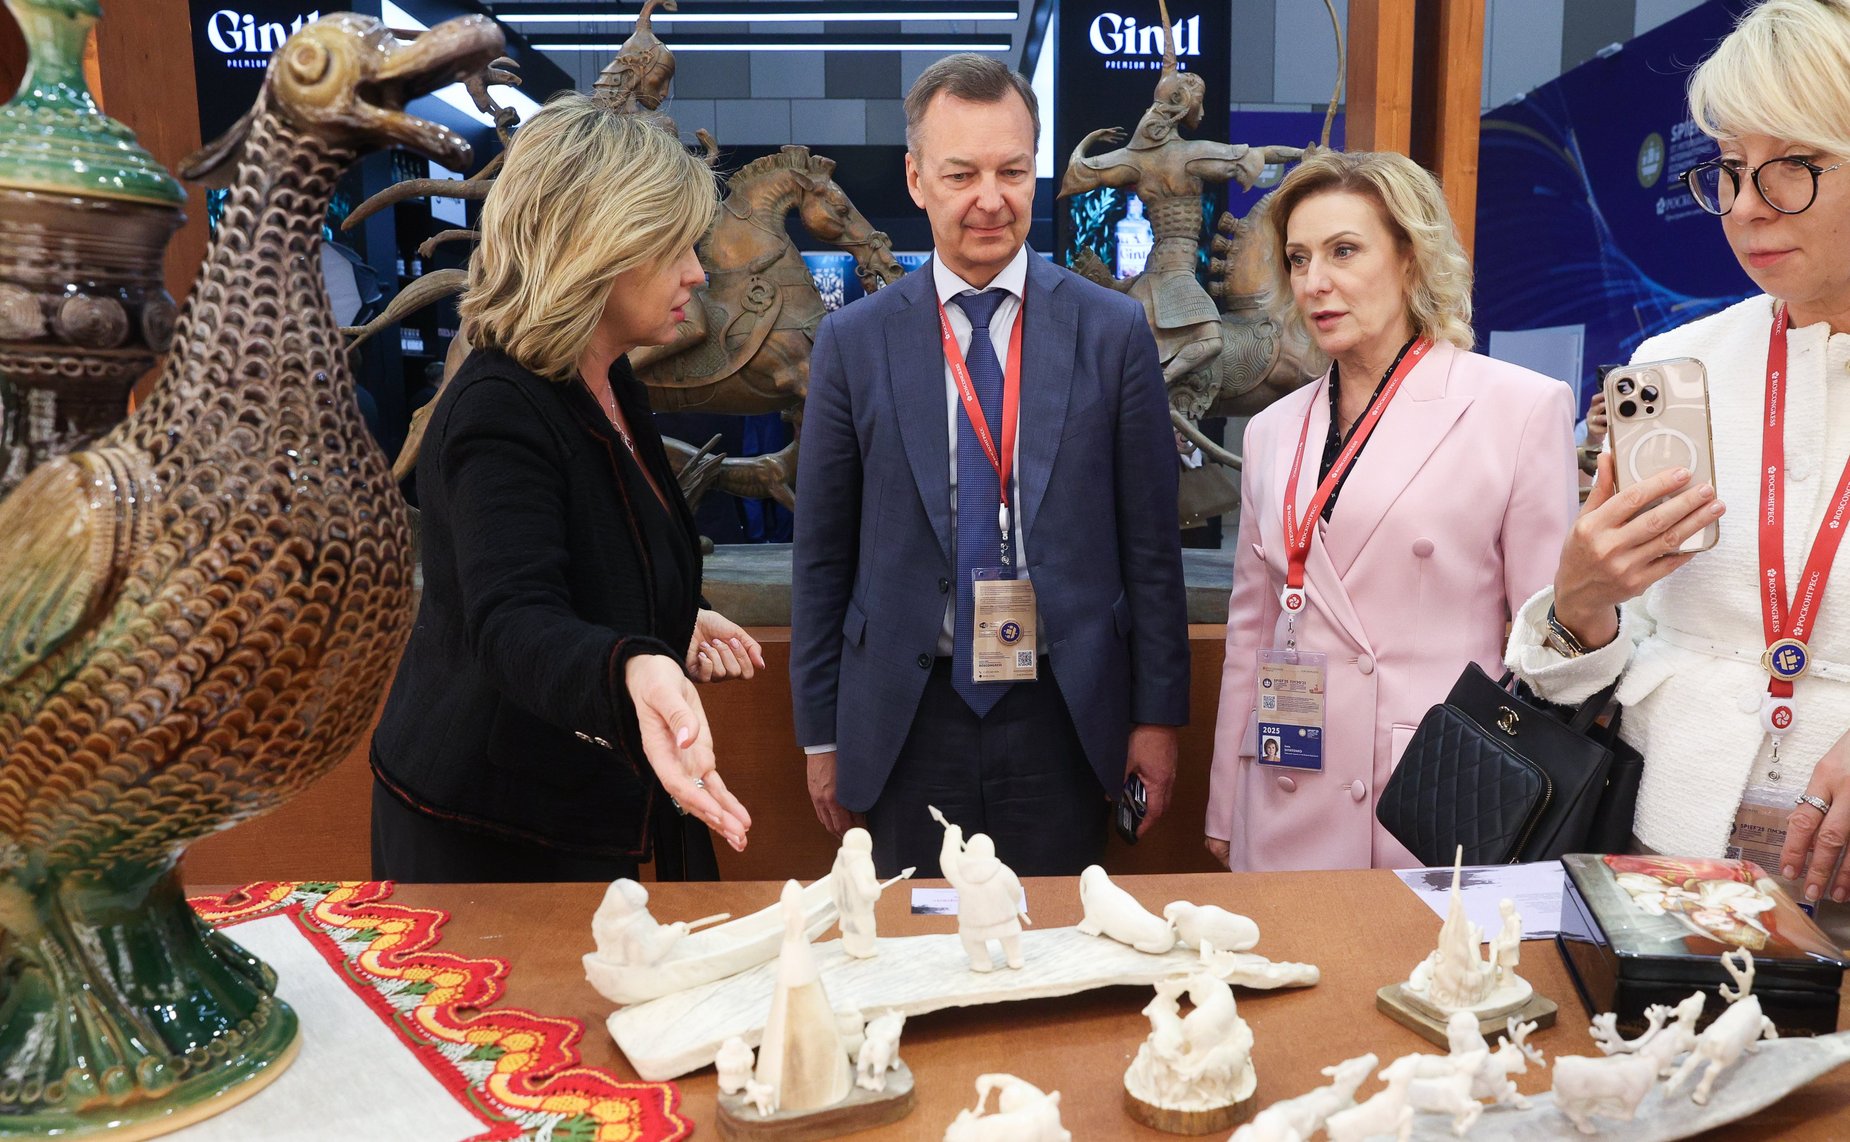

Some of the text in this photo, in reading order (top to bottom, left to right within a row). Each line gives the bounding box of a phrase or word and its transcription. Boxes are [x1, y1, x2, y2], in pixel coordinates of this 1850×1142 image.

[1089, 12, 1200, 56] Gintl
[226, 59, 268, 68] PREMIUM
[1105, 60, 1146, 70] PREMIUM
[1770, 380, 1778, 427] ROSCONGRESS
[1336, 440, 1358, 473] ROSCONGRESS
[1767, 474, 1776, 526] РОСКОНГРЕСС
[1287, 510, 1295, 548] ROSCONGRESS
[1302, 504, 1318, 542] РОСКОНГРЕСС
[1768, 577, 1780, 633] ROSCONGRESS
[1797, 571, 1820, 627] РОСКОНГРЕСС
[1262, 726, 1280, 734] 2025
[1740, 823, 1765, 832] SPIEF'25
